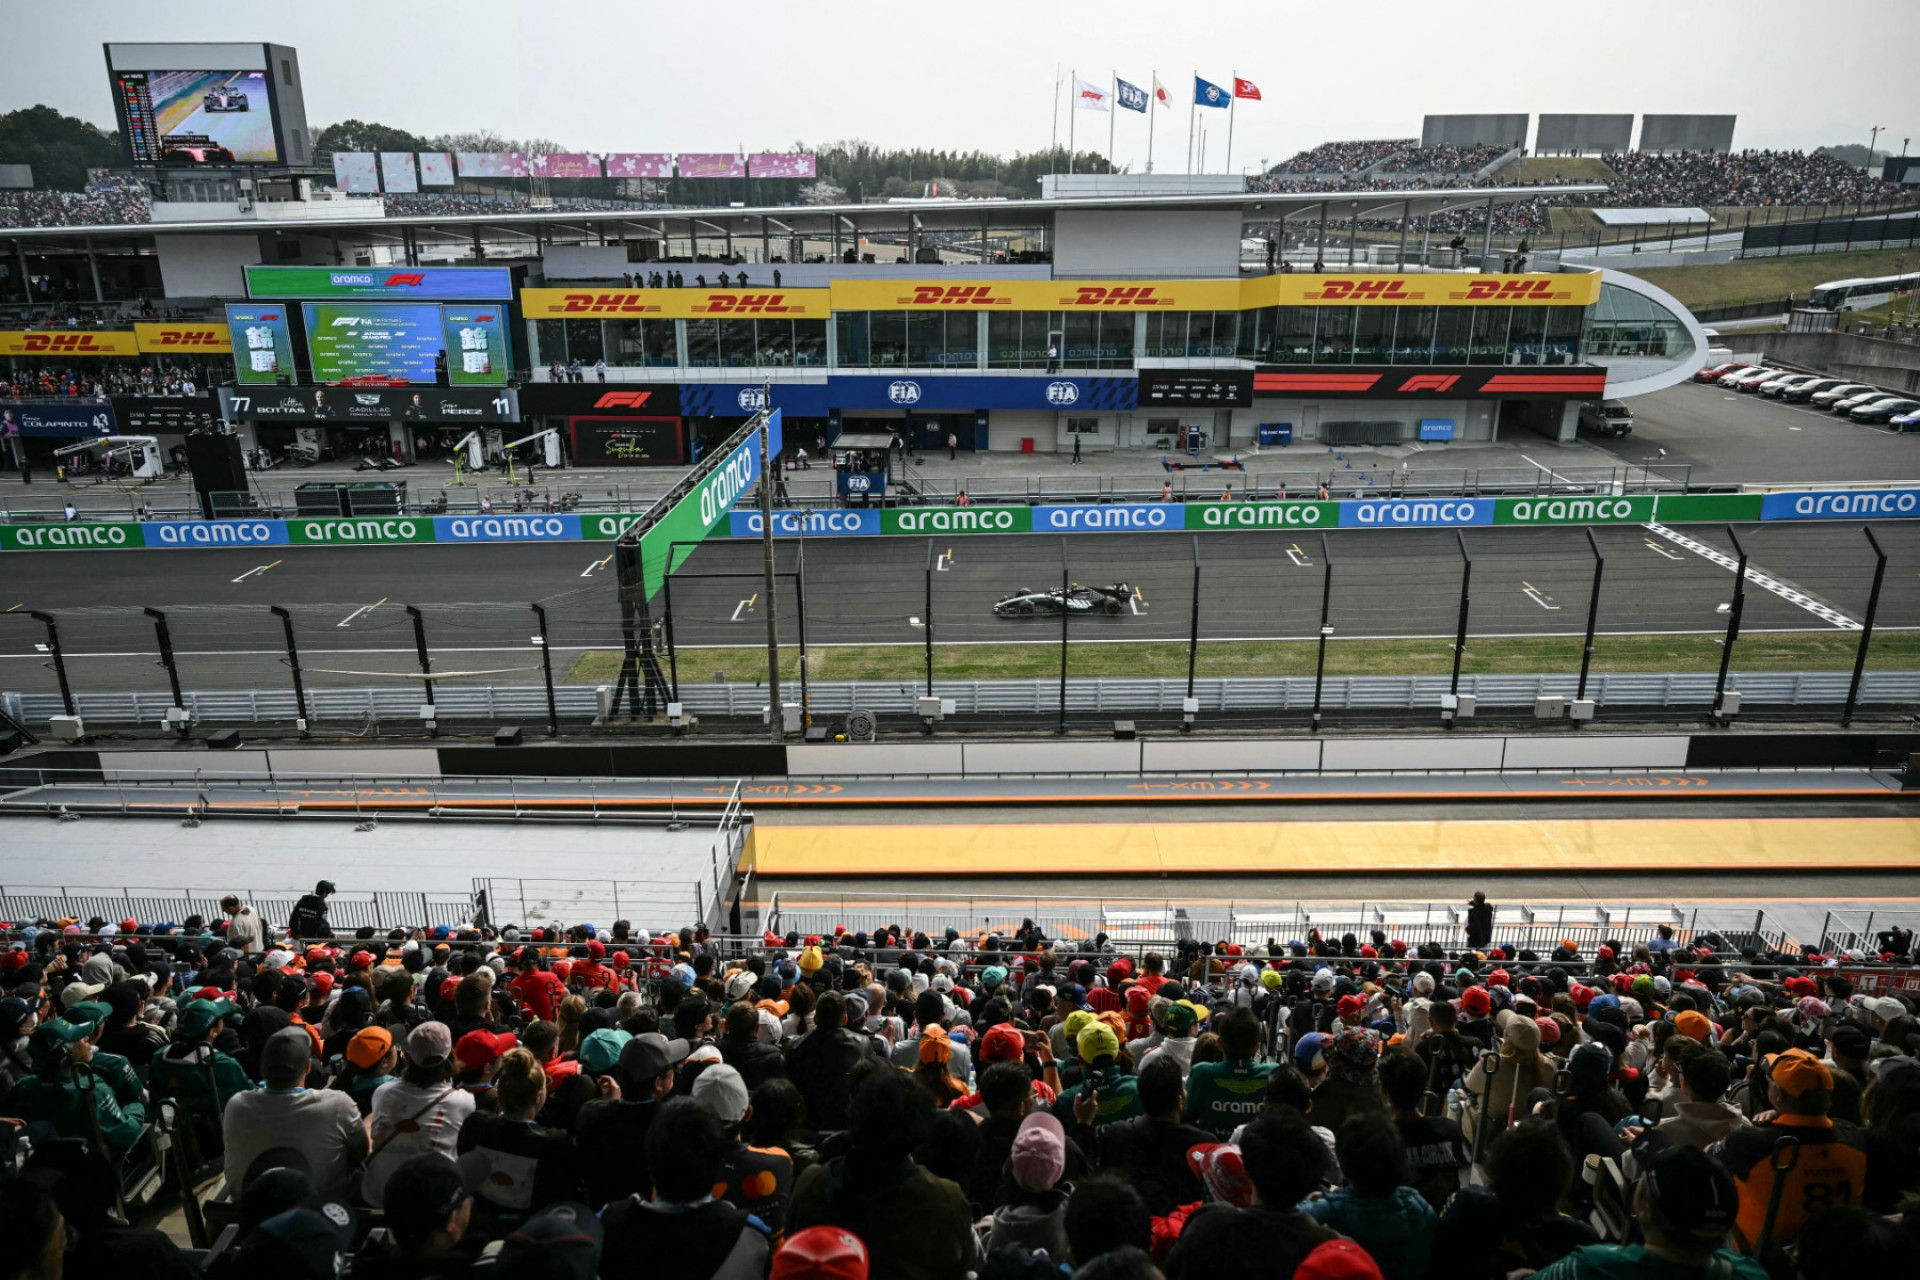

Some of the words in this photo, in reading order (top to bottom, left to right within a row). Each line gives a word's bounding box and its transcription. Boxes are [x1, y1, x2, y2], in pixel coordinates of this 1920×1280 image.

[333, 275, 371, 284] aramco
[384, 273, 425, 286] F1
[913, 287, 997, 304] DHL
[1074, 288, 1159, 305] DHL
[1320, 281, 1411, 299] DHL
[1465, 281, 1554, 299] DHL
[564, 295, 647, 312] DHL
[707, 295, 790, 313] DHL
[24, 334, 99, 351] DHL
[160, 331, 220, 345] DHL
[1397, 374, 1462, 392] F1
[230, 397, 250, 412] 77
[492, 398, 510, 414] 11
[593, 391, 652, 408] F1
[257, 406, 305, 414] BOTTAS
[92, 414, 109, 430] 43
[1423, 424, 1453, 432] aramco
[701, 447, 752, 527] aramco
[1358, 501, 1475, 523] aramco
[1513, 499, 1632, 520] aramco
[1795, 493, 1918, 514] aramco
[748, 513, 862, 532] aramco
[899, 507, 1013, 530] aramco
[1050, 505, 1166, 528] aramco
[1203, 504, 1321, 525] aramco
[160, 524, 270, 543] aramco
[305, 521, 416, 541] aramco
[451, 517, 563, 537] aramco
[16, 527, 126, 546] aramco
[1211, 1100, 1266, 1114] aramc
